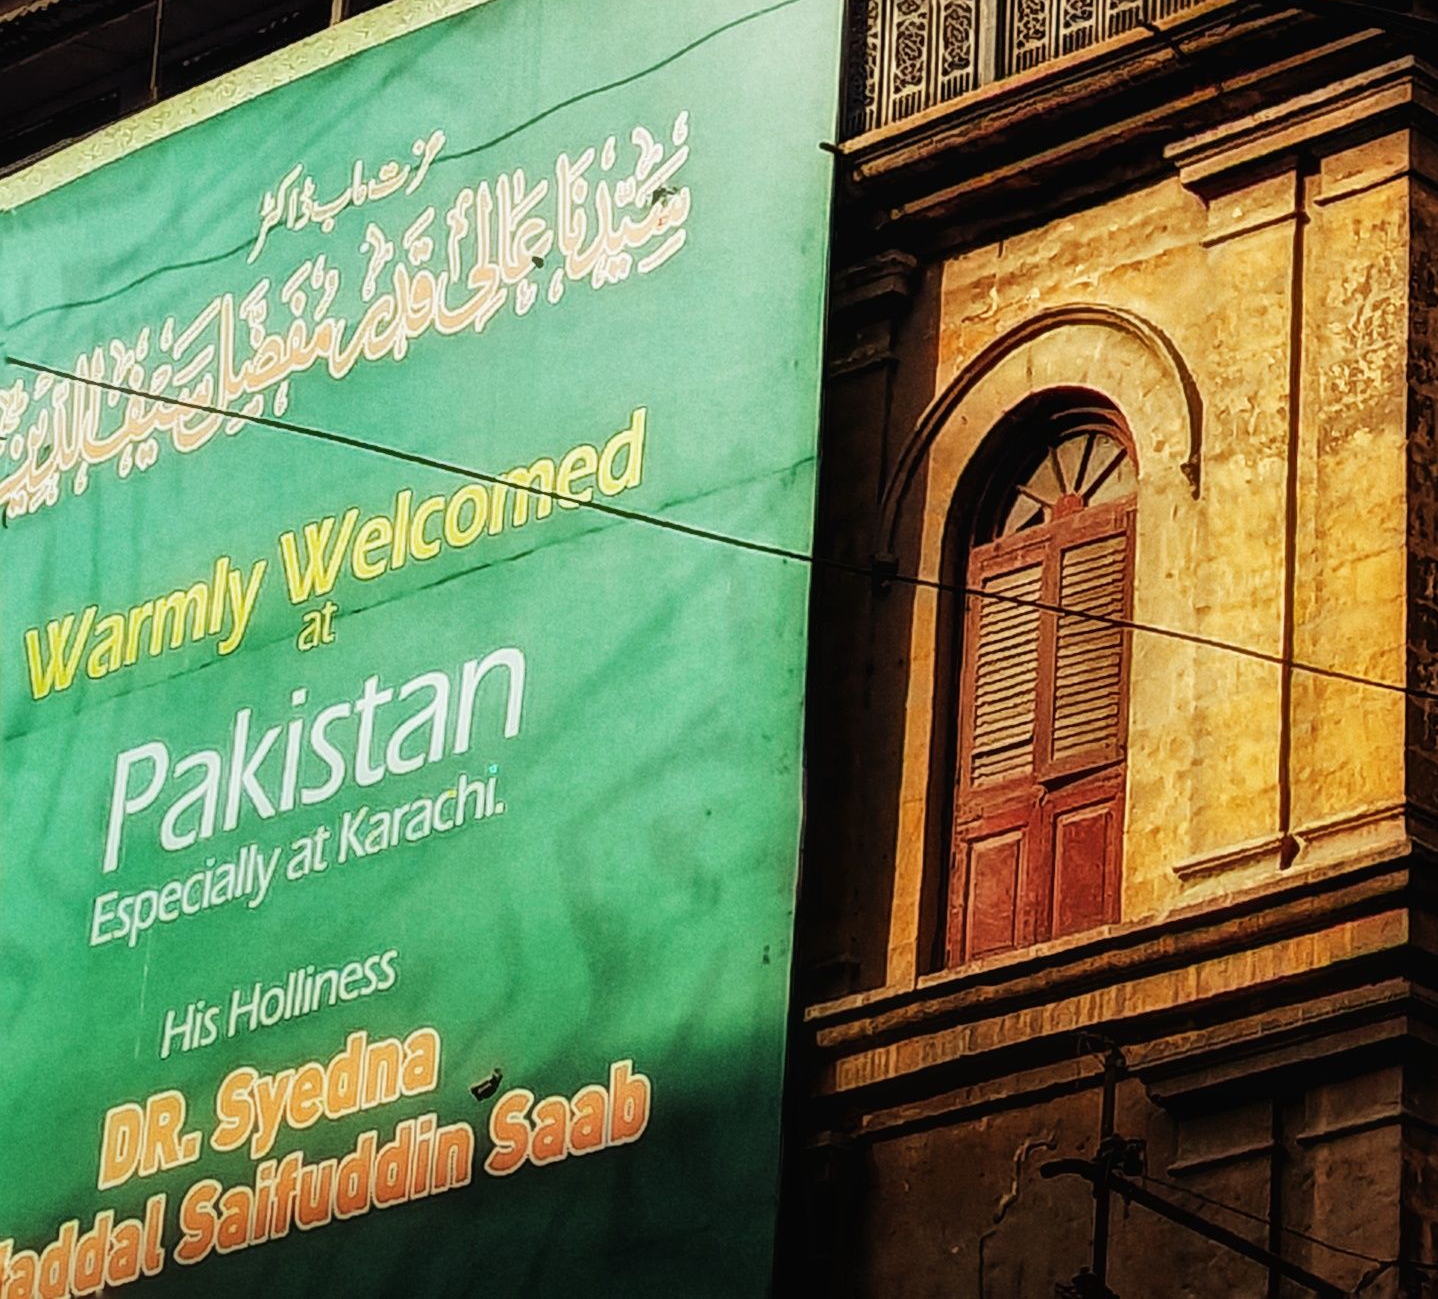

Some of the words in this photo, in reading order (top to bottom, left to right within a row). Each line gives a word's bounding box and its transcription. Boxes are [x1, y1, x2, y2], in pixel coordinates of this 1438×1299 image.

[25, 557, 267, 700] Warmly
[281, 406, 648, 605] Welcomed
[296, 601, 337, 652] at
[101, 646, 527, 873] Pakistan
[89, 841, 281, 948] Especially
[285, 825, 330, 880] at
[338, 762, 506, 866] Karachi.
[160, 997, 217, 1059] His
[226, 949, 399, 1039] Holliness
[0, 1191, 167, 1299] addal
[173, 1111, 474, 1267] Saifuddin
[485, 1059, 653, 1178] Saab
[97, 1090, 203, 1191] DR.
[210, 1028, 442, 1161] Syedna
